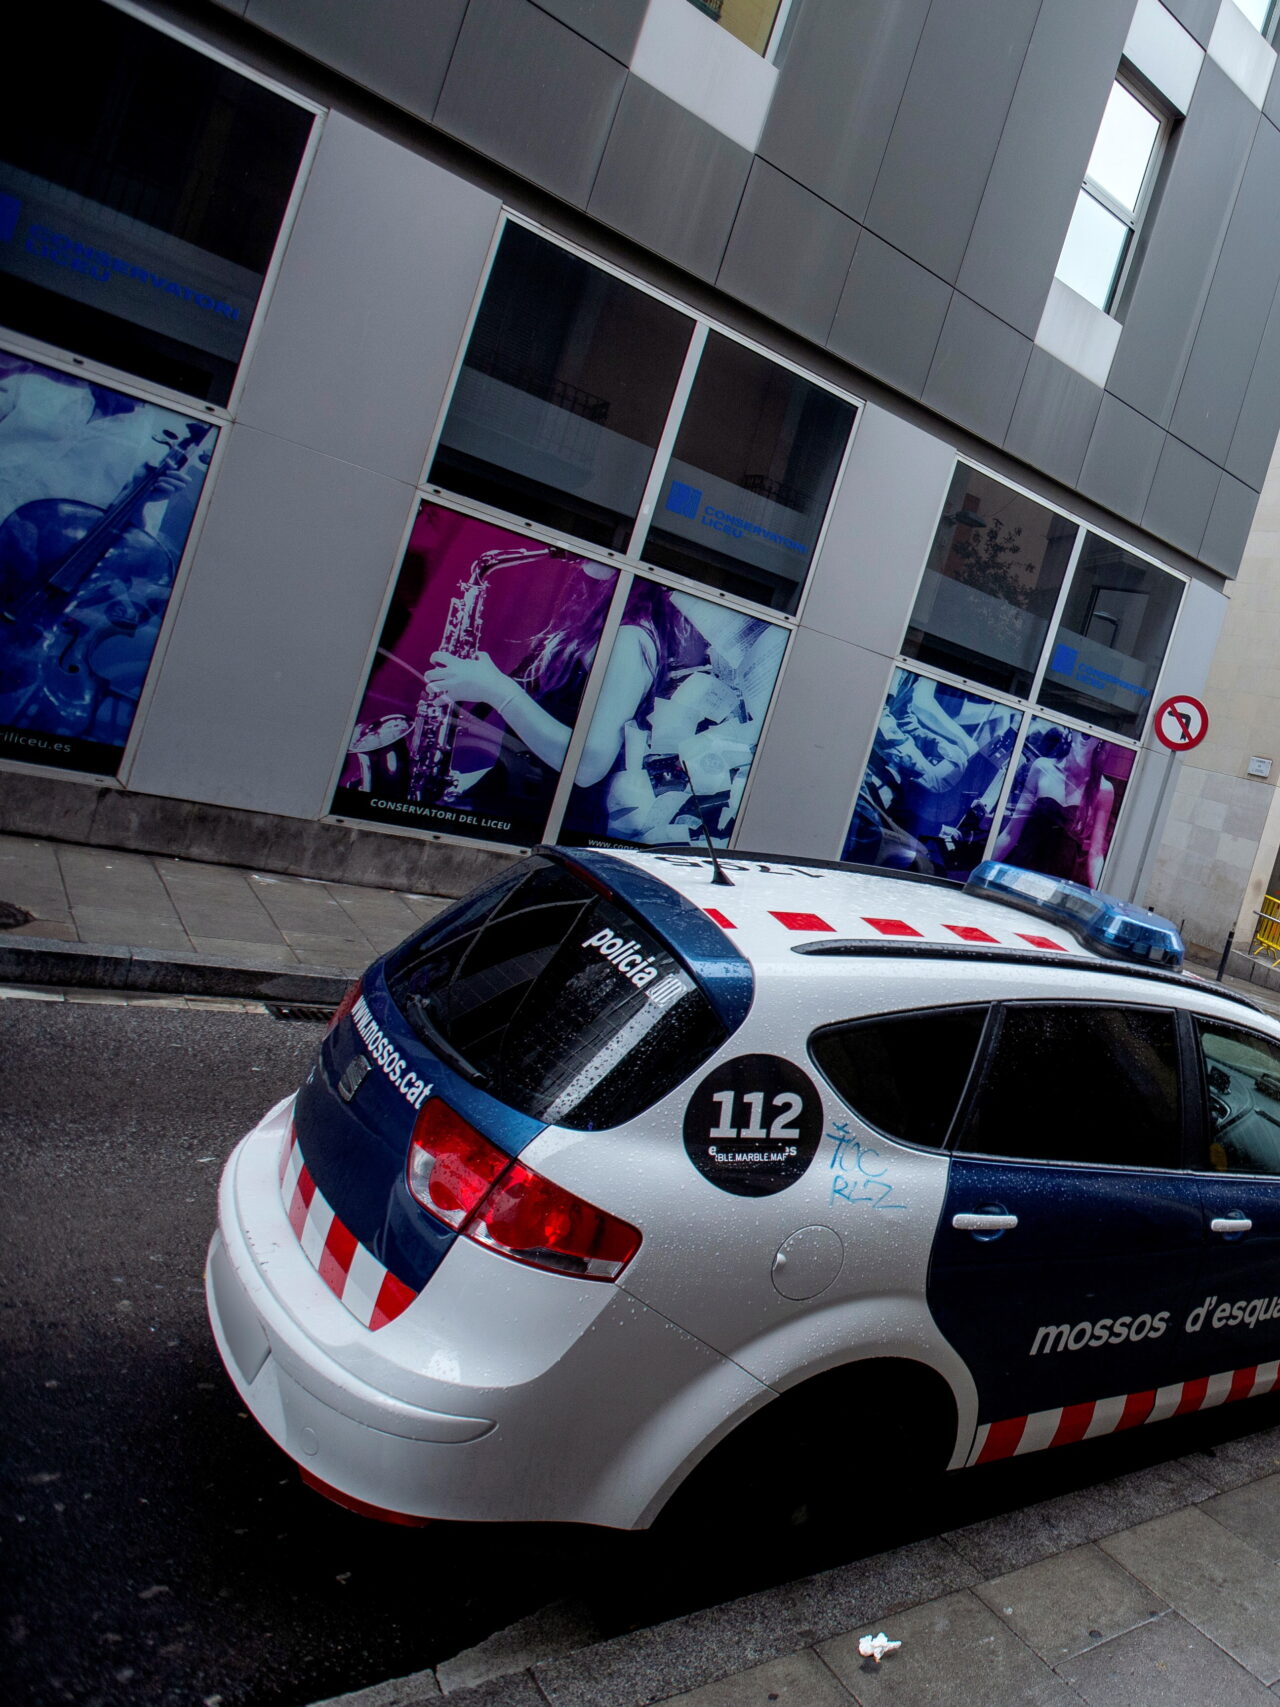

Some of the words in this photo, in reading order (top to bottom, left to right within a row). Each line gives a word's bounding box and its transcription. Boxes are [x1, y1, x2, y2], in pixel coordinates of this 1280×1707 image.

[26, 238, 111, 283] LICEU
[29, 224, 240, 321] CONSERVATORI
[701, 515, 743, 539] LICEU
[0, 730, 72, 753] iliceu.es
[370, 798, 456, 822] CONSERVATORI
[458, 814, 479, 826] DEL
[481, 817, 512, 831] LICEU
[581, 928, 658, 988] policia
[351, 994, 434, 1110] www.mossos.cat
[709, 1090, 804, 1139] 112
[1029, 1310, 1171, 1356] mossos
